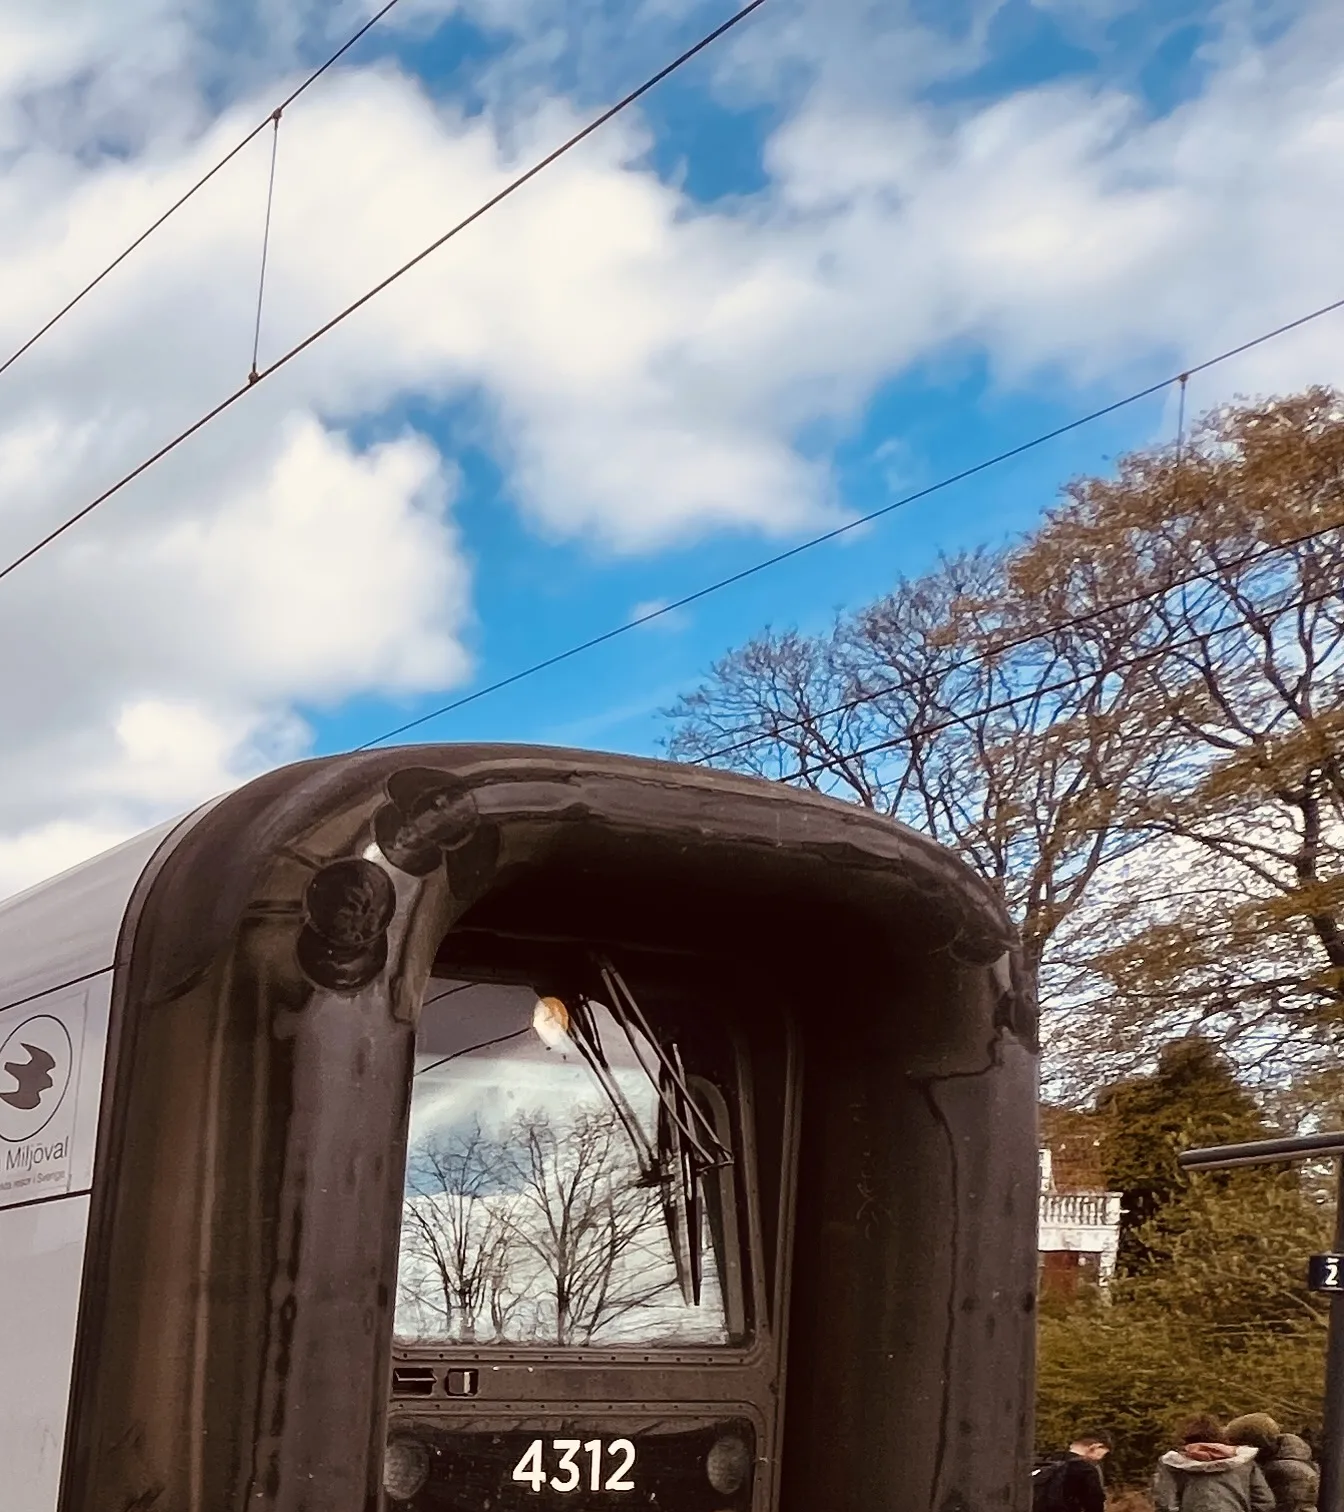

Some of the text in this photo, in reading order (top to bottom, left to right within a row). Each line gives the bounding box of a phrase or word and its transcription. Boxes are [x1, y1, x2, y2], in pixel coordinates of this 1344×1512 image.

[6, 1136, 69, 1172] Miljöval
[1324, 1264, 1338, 1286] 2
[512, 1438, 636, 1492] 4312
